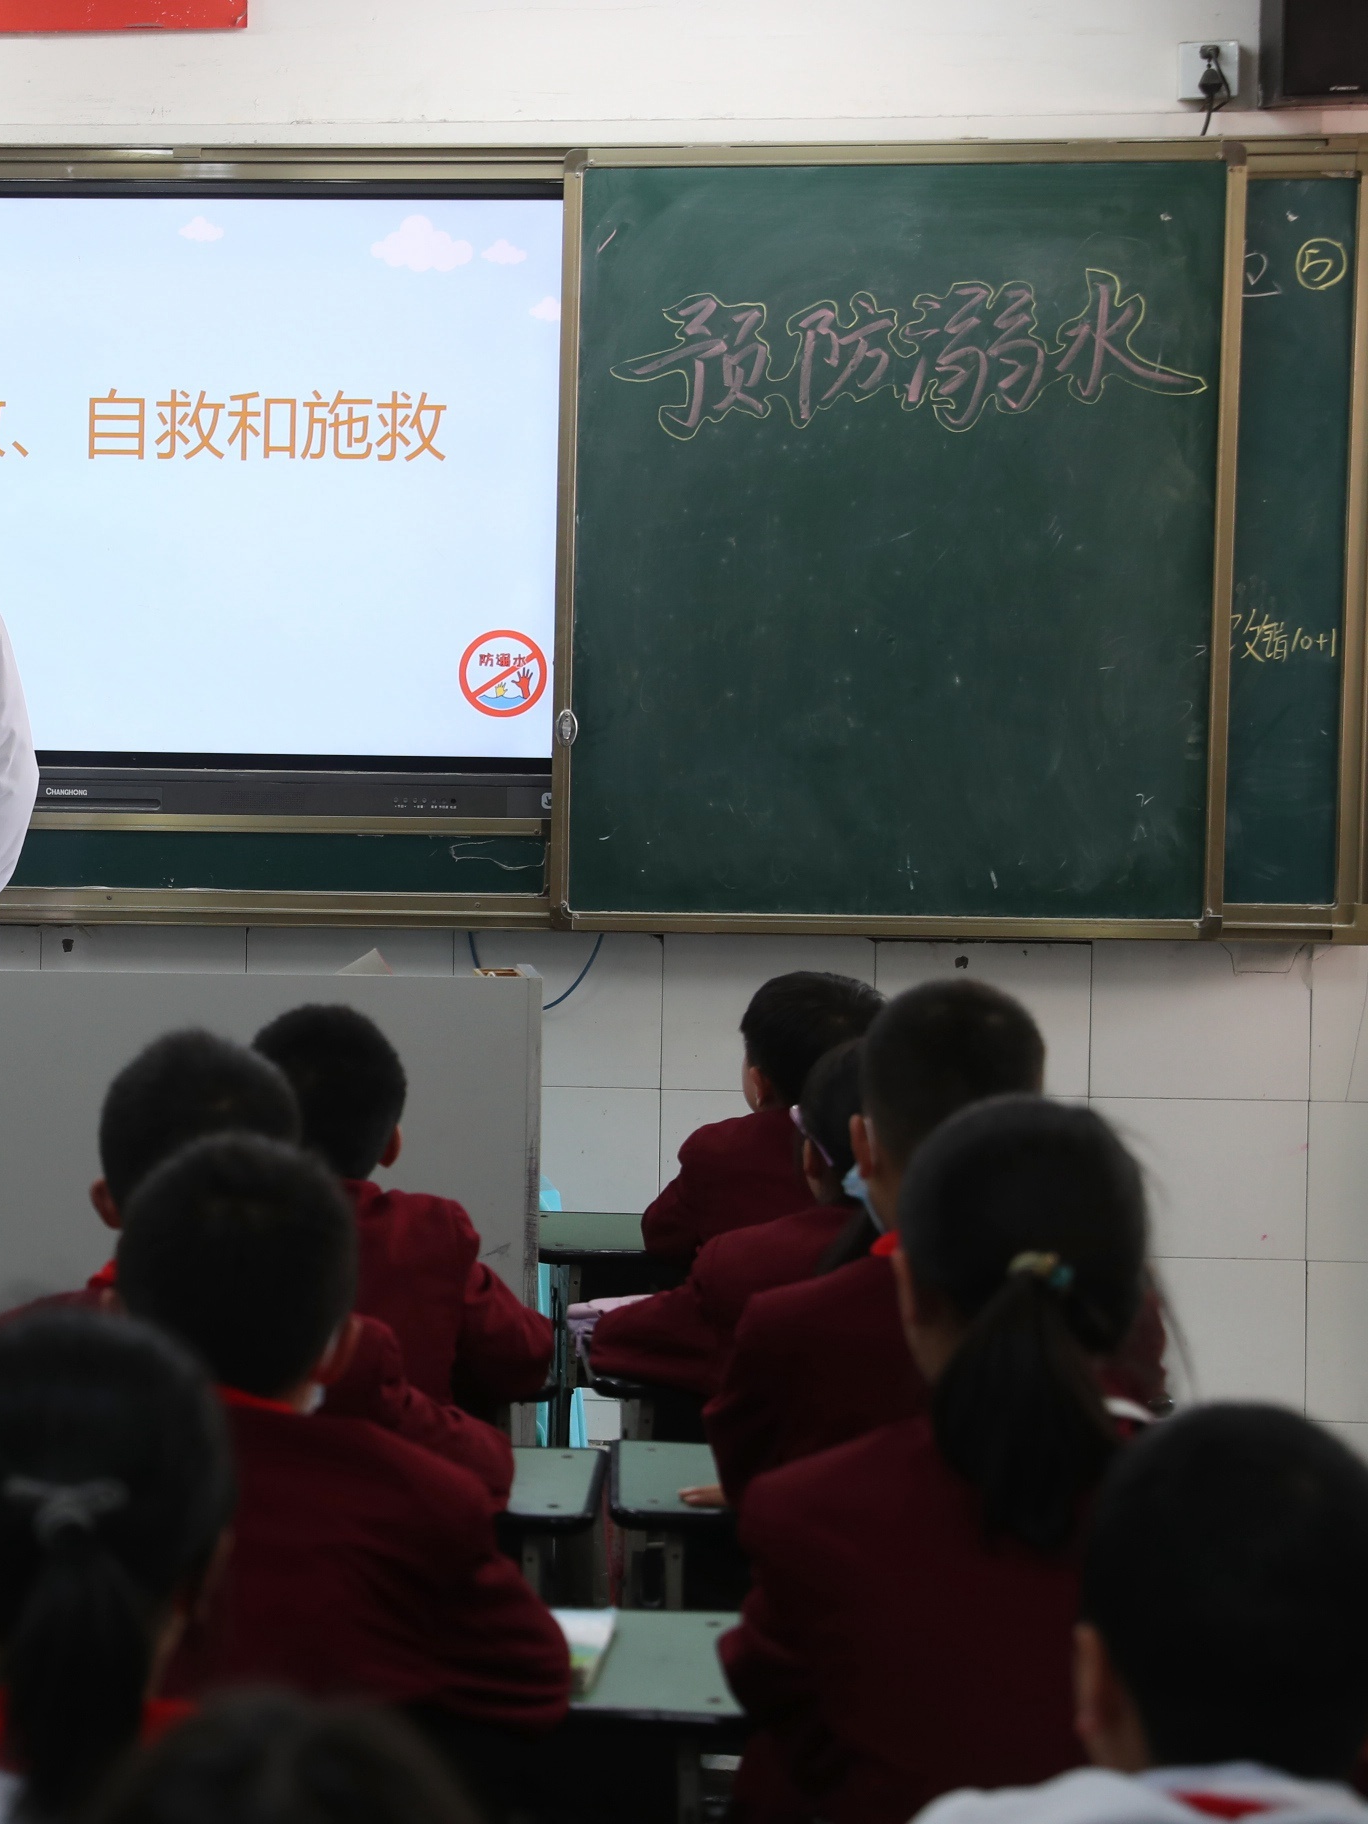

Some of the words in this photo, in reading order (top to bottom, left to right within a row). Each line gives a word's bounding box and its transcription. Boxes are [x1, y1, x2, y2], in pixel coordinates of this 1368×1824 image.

[610, 269, 1208, 440] 预防溺水
[45, 787, 88, 796] CHANGHONG
